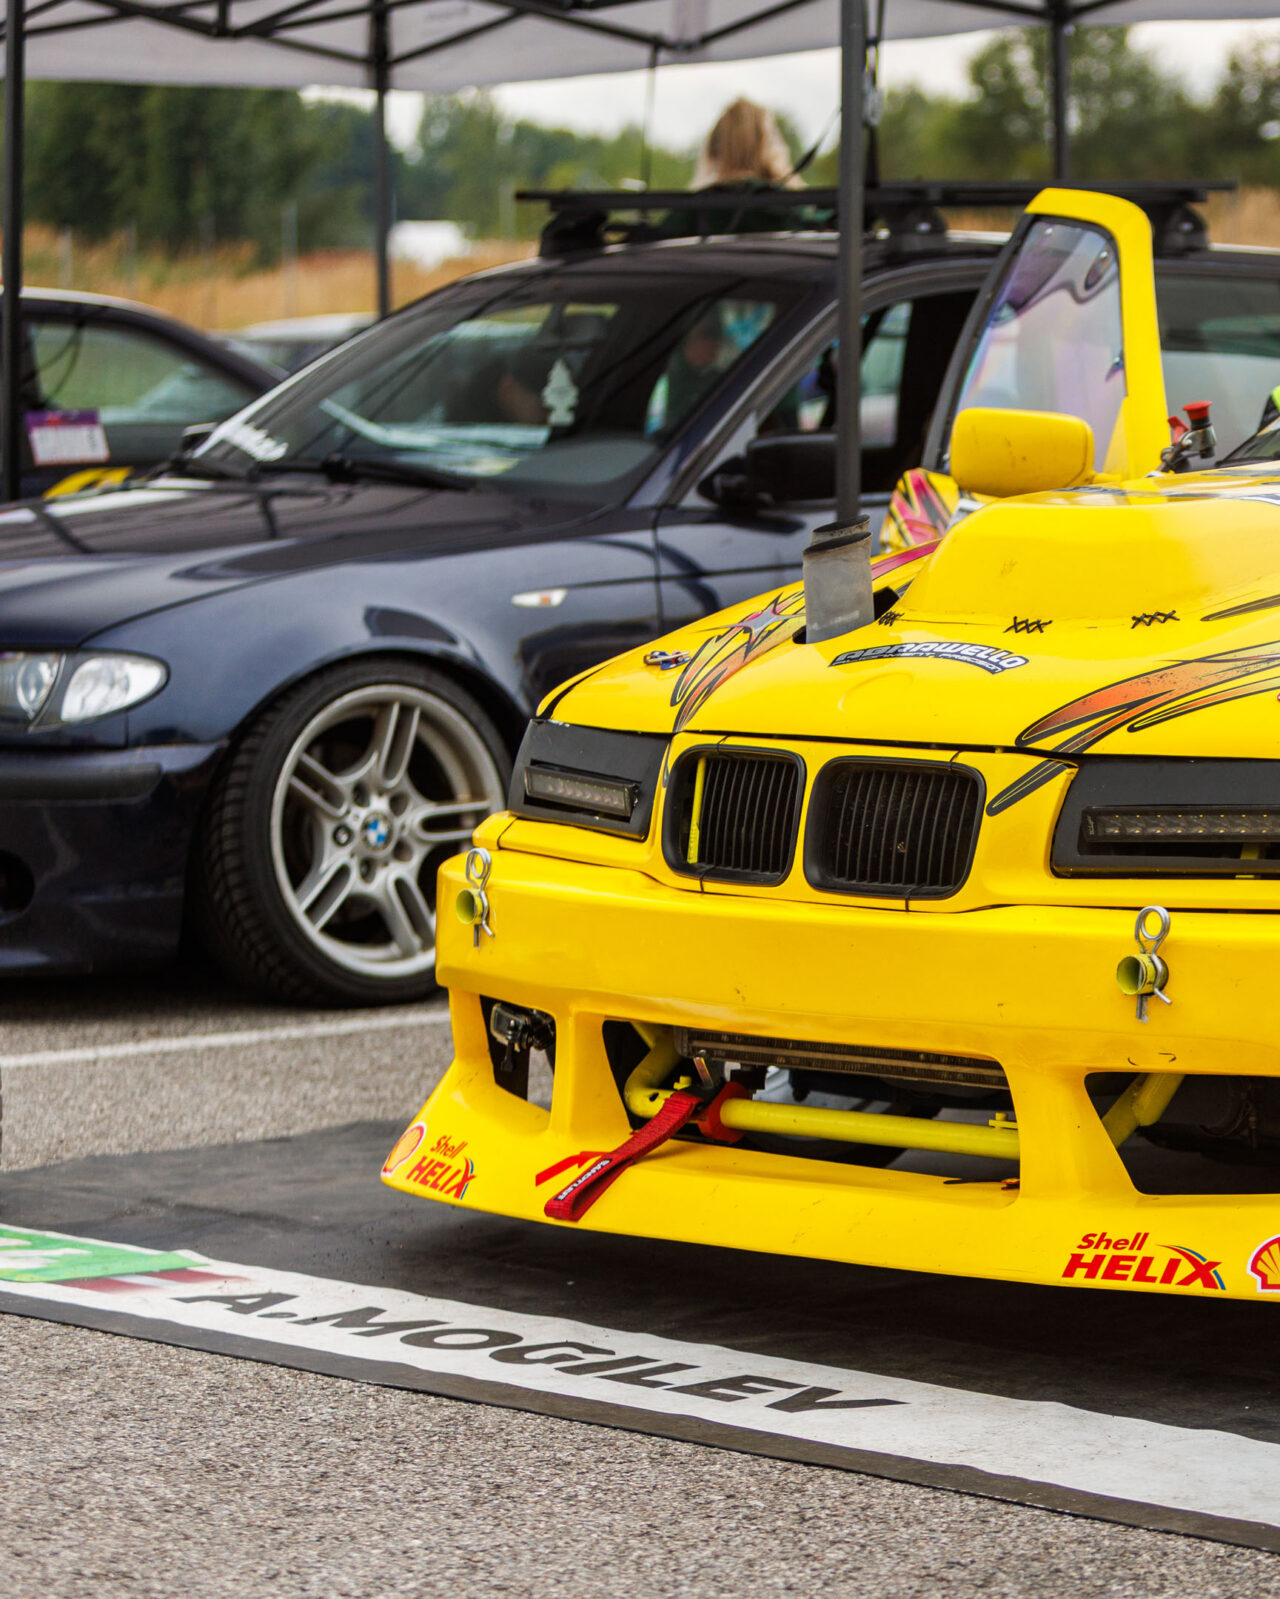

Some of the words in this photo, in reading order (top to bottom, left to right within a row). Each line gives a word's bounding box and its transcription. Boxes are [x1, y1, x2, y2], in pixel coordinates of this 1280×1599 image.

[430, 1135, 468, 1159] Shell
[405, 1156, 477, 1200] HELIX
[1076, 1231, 1150, 1251] Shell
[1061, 1243, 1227, 1291] HELIX
